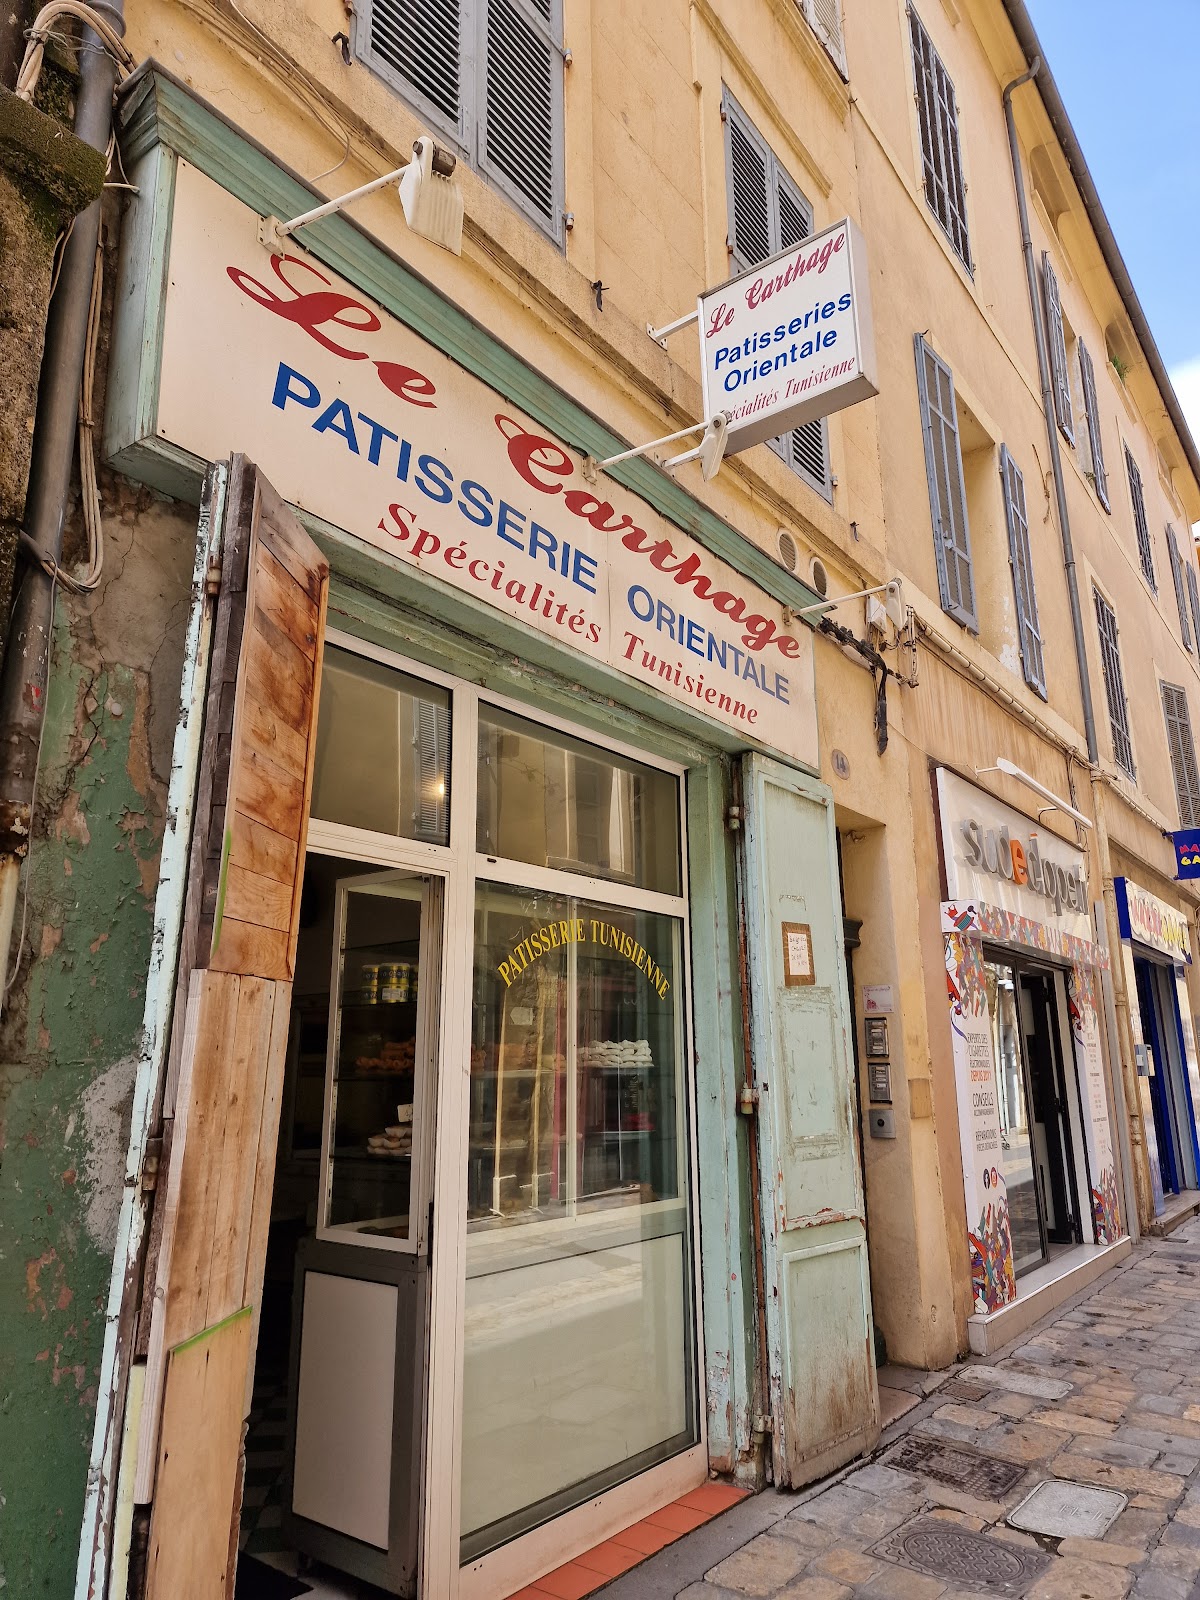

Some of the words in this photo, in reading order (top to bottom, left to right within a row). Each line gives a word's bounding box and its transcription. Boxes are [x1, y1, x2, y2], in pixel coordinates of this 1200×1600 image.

[706, 303, 735, 339] Le
[745, 232, 845, 310] Carthage
[714, 293, 851, 370] Patisseries
[724, 330, 837, 392] Orientale
[730, 388, 779, 421] écialités
[784, 357, 855, 398] Tunisienne
[226, 254, 437, 408] Le
[494, 414, 800, 658] Carthage
[272, 362, 598, 594] PATISSERIE
[627, 585, 790, 705] ORIENTALE
[377, 503, 601, 643] Spécialités
[622, 631, 758, 724] Tunisienne
[836, 754, 846, 772] 14
[1179, 844, 1200, 854] MA
[497, 918, 586, 988] PATISSERIE
[590, 919, 671, 1000] TUNISIENNE
[973, 1092, 993, 1107] CONSEILS
